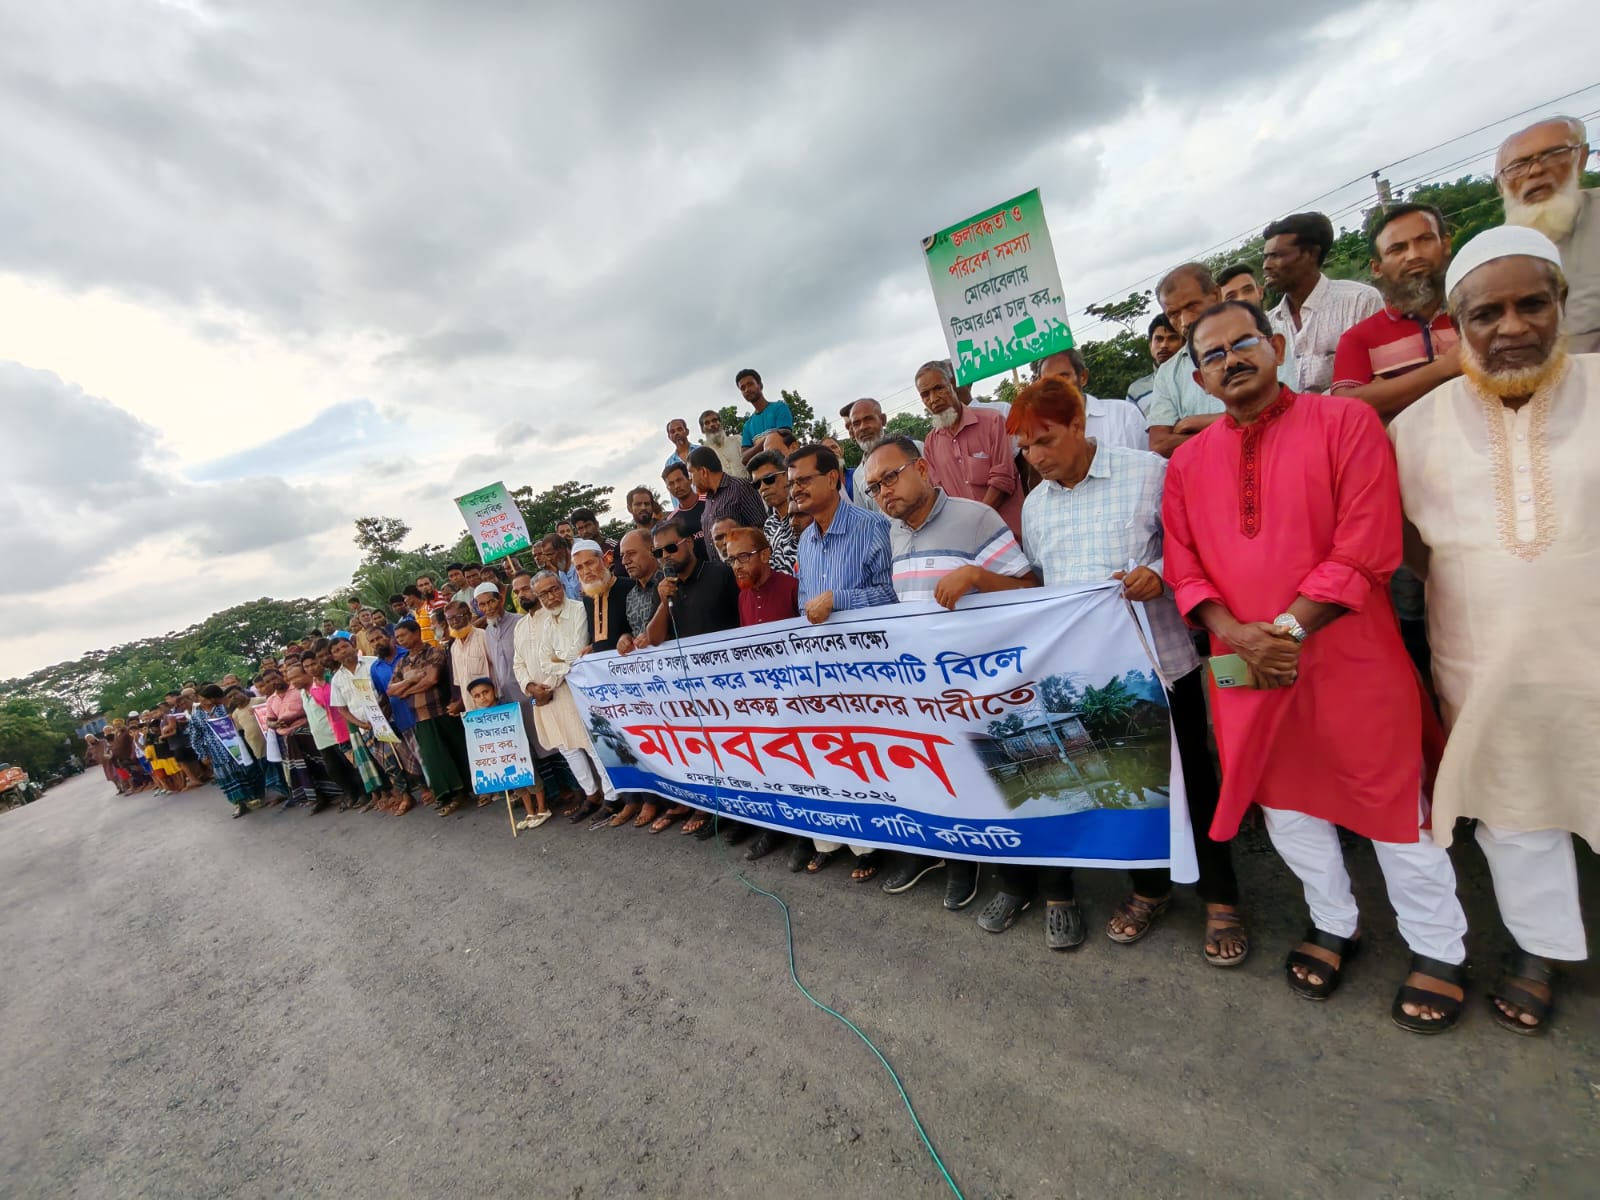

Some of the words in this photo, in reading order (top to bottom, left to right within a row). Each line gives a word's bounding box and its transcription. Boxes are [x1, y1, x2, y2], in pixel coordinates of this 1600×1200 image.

[1010, 206, 1023, 222] ও
[948, 250, 991, 280] পরিবেশ
[993, 232, 1032, 261] সমস্যা
[964, 265, 1029, 304] মোকাবেলায়
[950, 305, 1001, 339] টিআরএম
[1004, 295, 1029, 318] চালু
[643, 675, 671, 696] নদী
[672, 677, 706, 694] খনন
[707, 674, 747, 690] করে
[933, 646, 1028, 685] বিলে
[657, 658, 664, 671] ও
[690, 649, 730, 667] অঞ্চলের
[730, 639, 789, 662] জলাবদ্ধতা
[789, 632, 846, 656] নিরসনের
[847, 630, 889, 650] লক্ষ্যে
[660, 698, 730, 721] (TRM)
[734, 697, 779, 717] প্রকল্প
[782, 691, 908, 719] বাস্তবায়নের
[913, 680, 1038, 723] দাবীতে
[479, 742, 496, 753] চালু
[623, 720, 957, 798] মানববন্ধন
[763, 782, 784, 791] ২৫
[718, 795, 776, 818] ডুমুরিয়া
[776, 799, 863, 833] উপজেলা
[870, 813, 926, 842] পানি
[929, 824, 1023, 850] কমিটি
